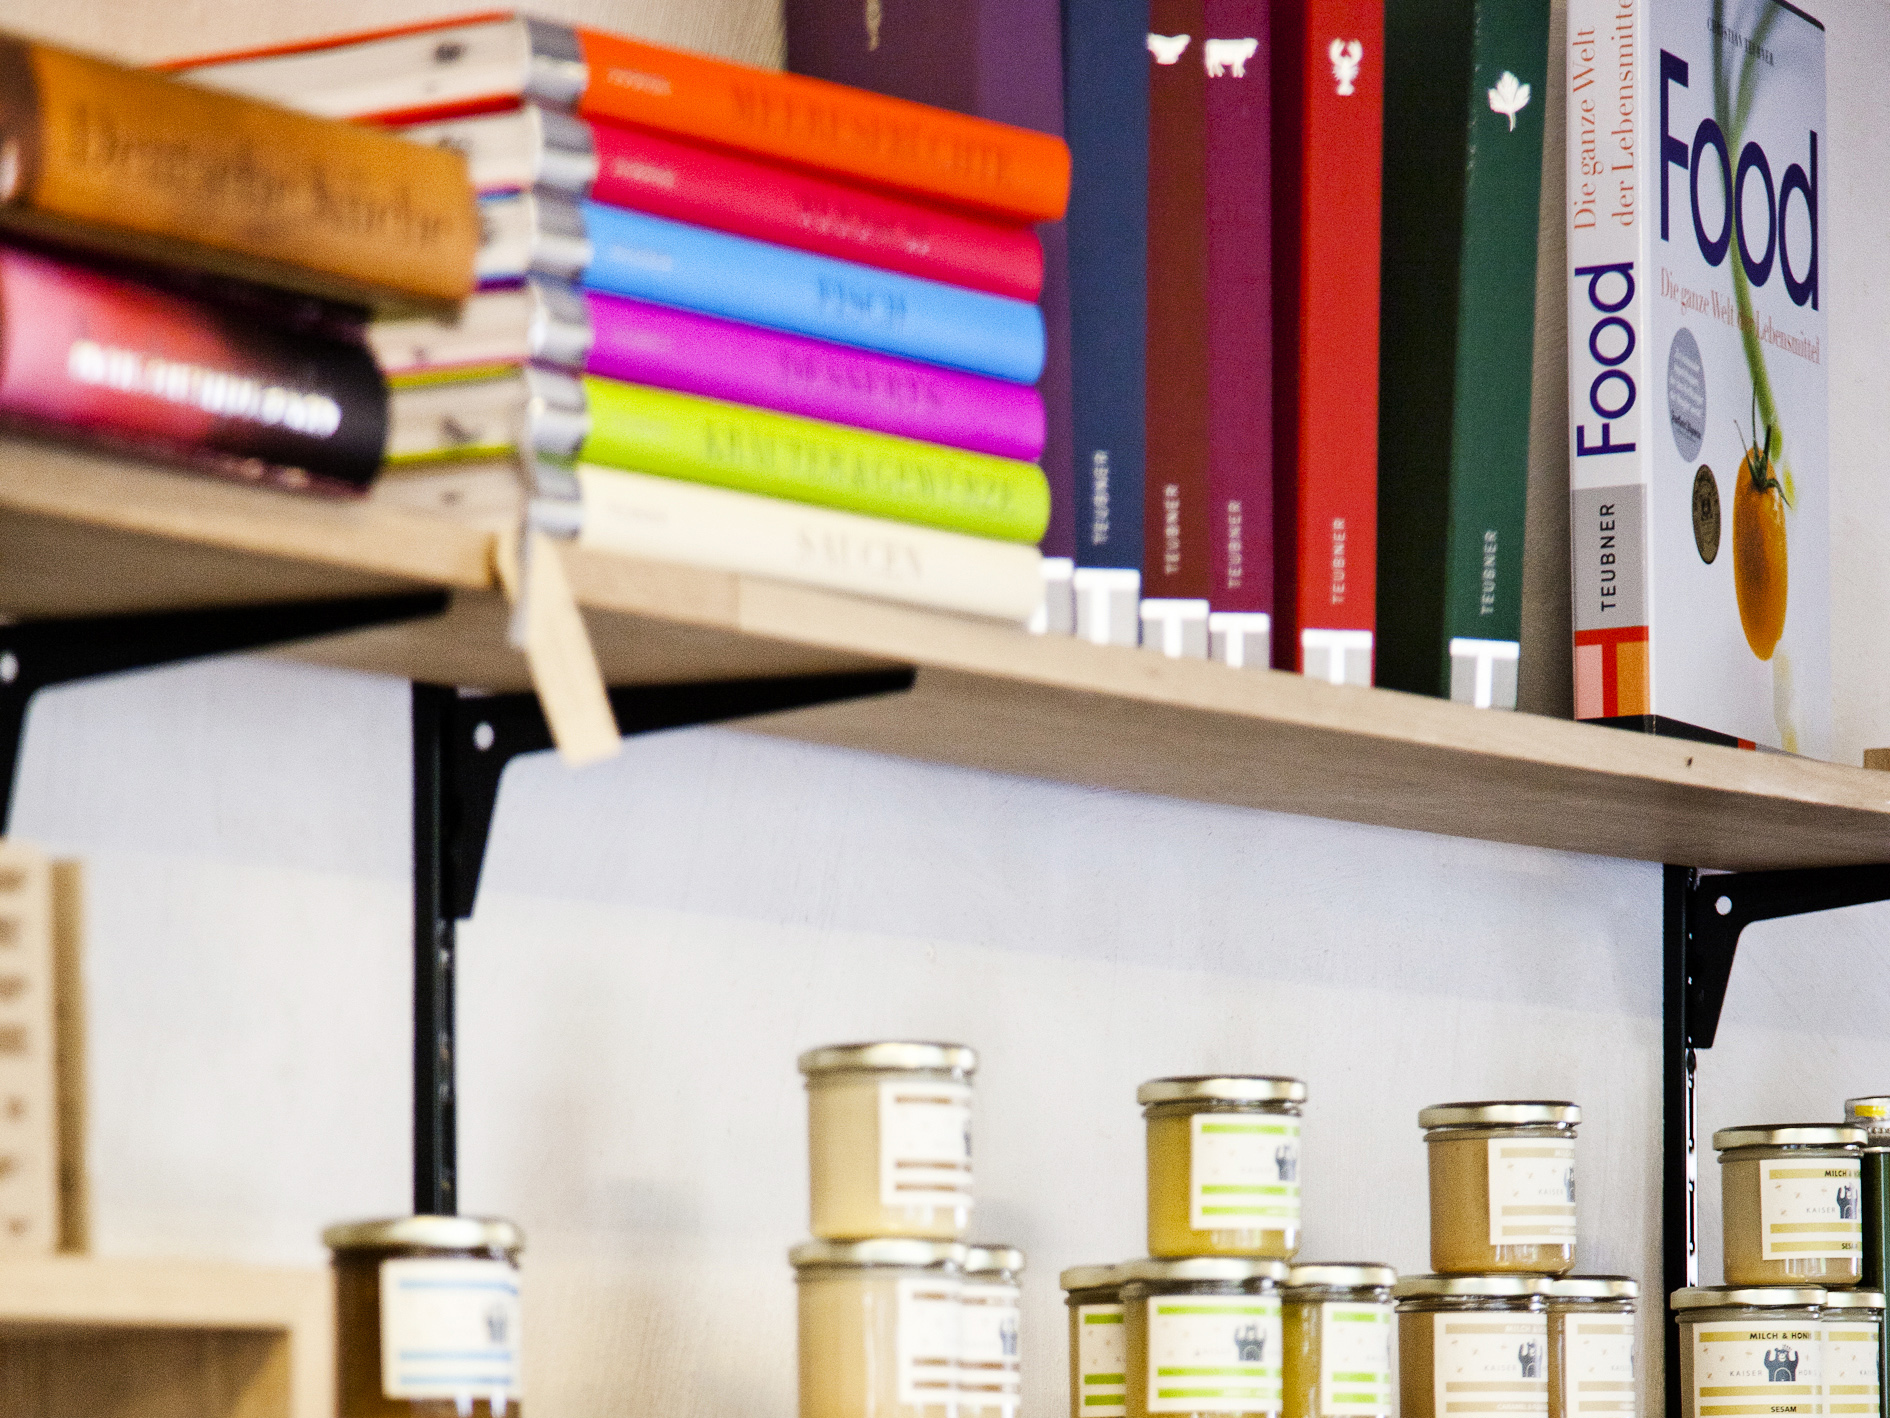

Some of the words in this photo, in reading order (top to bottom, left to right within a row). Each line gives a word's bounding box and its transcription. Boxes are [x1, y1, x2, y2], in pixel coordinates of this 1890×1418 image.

[1572, 25, 1596, 93] Welt
[1579, 98, 1604, 177] ganze
[1573, 187, 1597, 230] Die
[1611, 184, 1635, 227] der
[1660, 48, 1819, 312] Food
[1660, 266, 1679, 300] Die
[1711, 289, 1734, 327] Welt
[1574, 261, 1637, 457] Food
[1163, 483, 1180, 575] TEUBNER
[1227, 500, 1243, 589] TEUBNER
[1331, 517, 1346, 606] TEUBNER
[1600, 502, 1617, 613] TEUBNER
[1480, 529, 1498, 616] TEUBNER
[1806, 1206, 1836, 1214] KAISER
[1729, 1369, 1763, 1377] KAISER
[1749, 1332, 1778, 1340] MILCH
